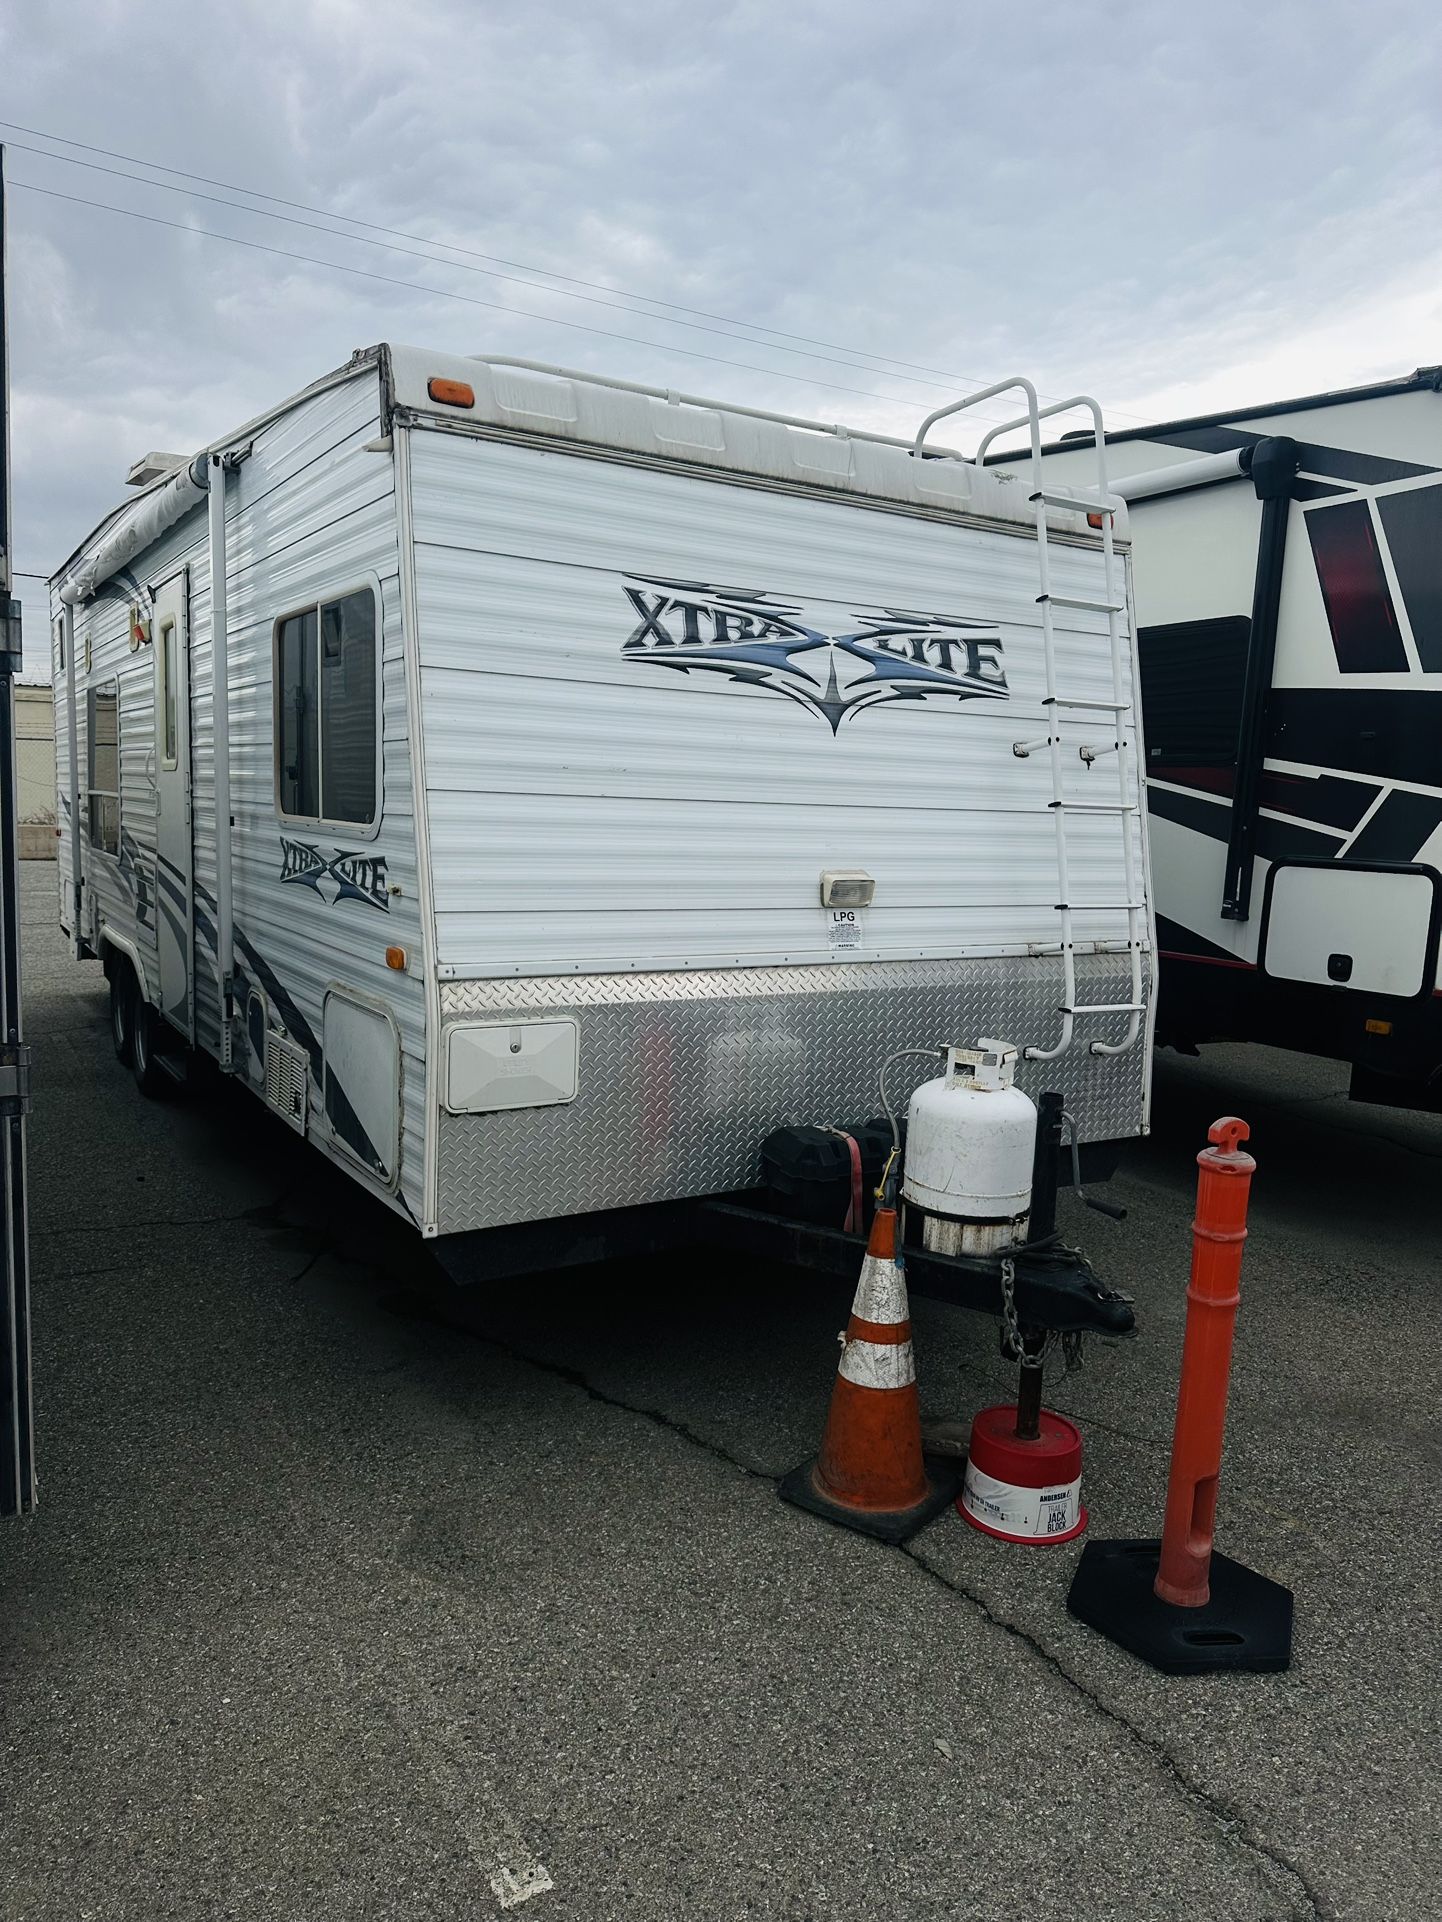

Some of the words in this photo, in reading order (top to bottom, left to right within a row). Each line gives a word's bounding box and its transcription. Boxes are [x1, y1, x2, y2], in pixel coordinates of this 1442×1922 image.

[620, 585, 804, 651] XTRA
[873, 636, 1009, 691] LITE
[279, 836, 321, 881] XTRA
[340, 856, 389, 909] LITE
[833, 911, 855, 922] LPG
[1040, 1492, 1067, 1502] ANDERSEN
[1048, 1503, 1068, 1513] TRAILER
[1048, 1510, 1067, 1524] JACK
[1047, 1521, 1067, 1533] BLOCK
